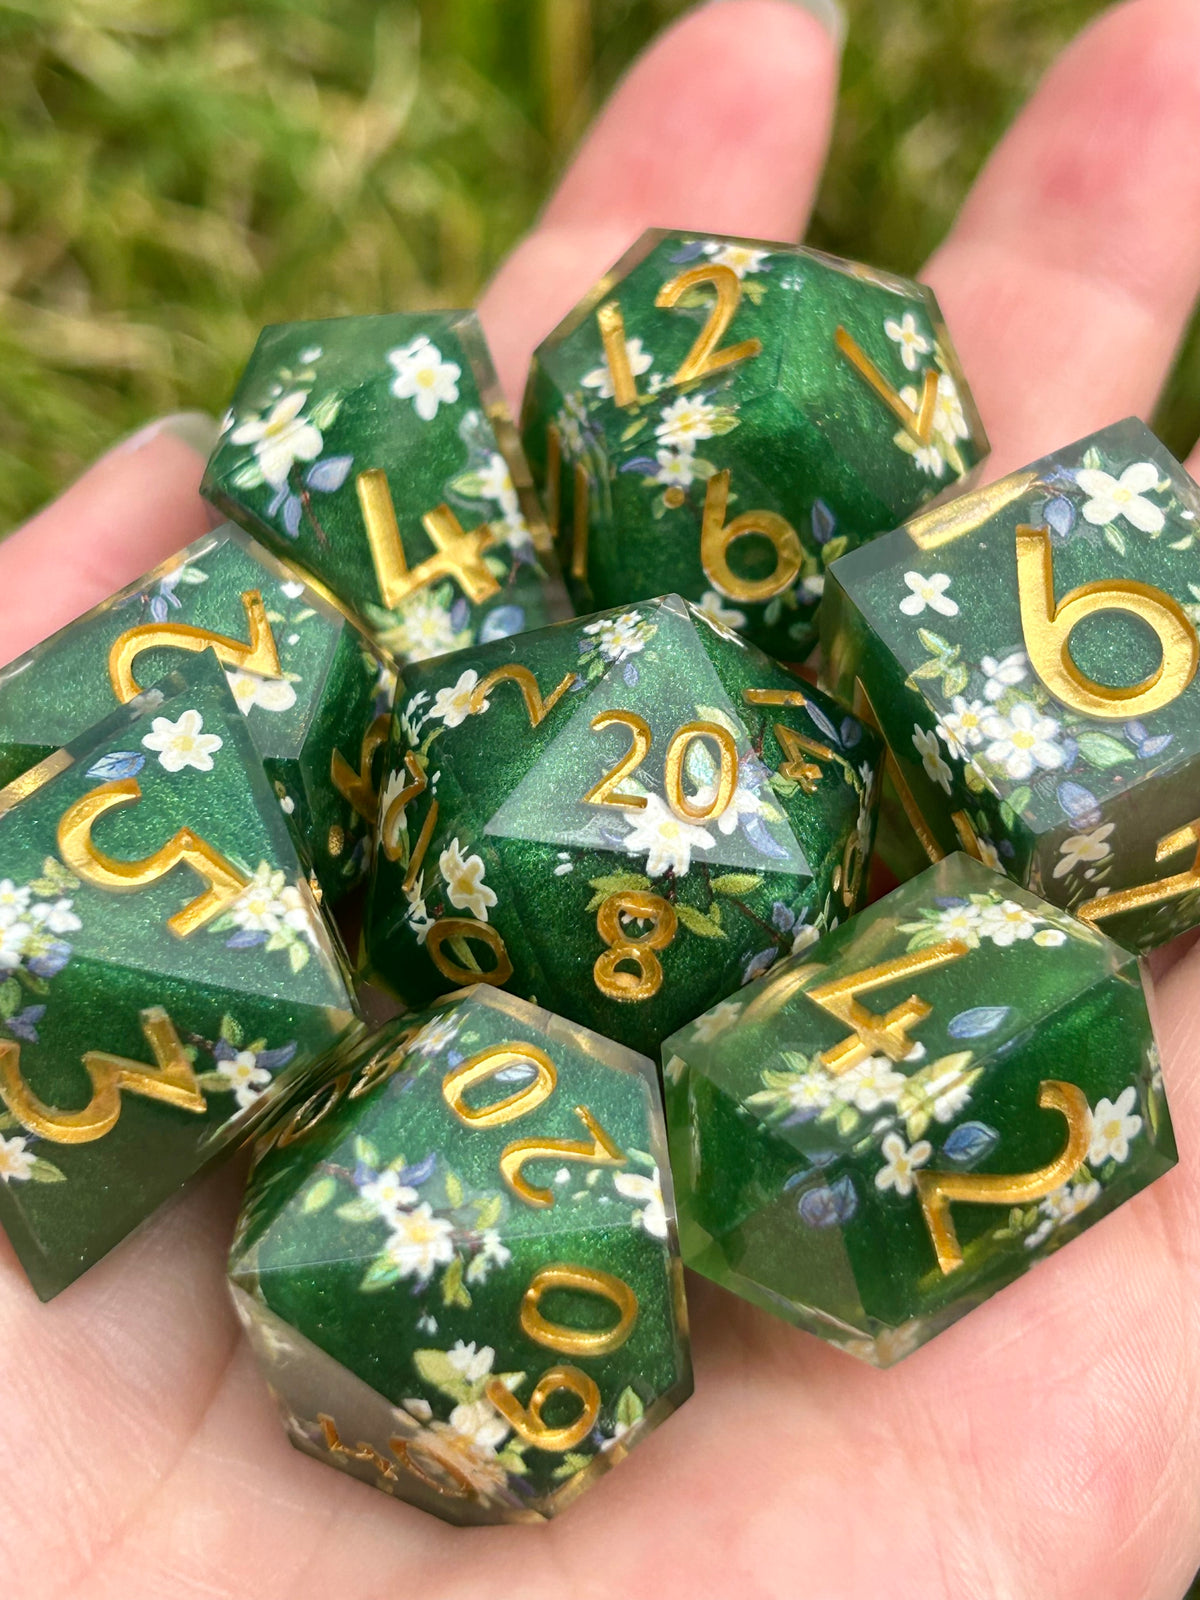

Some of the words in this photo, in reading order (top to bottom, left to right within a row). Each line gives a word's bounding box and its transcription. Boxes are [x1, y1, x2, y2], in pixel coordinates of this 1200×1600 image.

[597, 263, 762, 408] 12
[355, 467, 502, 610] 4
[109, 589, 282, 703] 2
[1015, 523, 1199, 722] 6
[469, 664, 581, 728] 2
[583, 709, 739, 825] 20
[57, 778, 252, 940] 5
[593, 890, 680, 1001] 8
[804, 938, 969, 1078] 4
[0, 1004, 208, 1144] 3
[441, 1040, 628, 1208] 20
[914, 1079, 1092, 1276] 2
